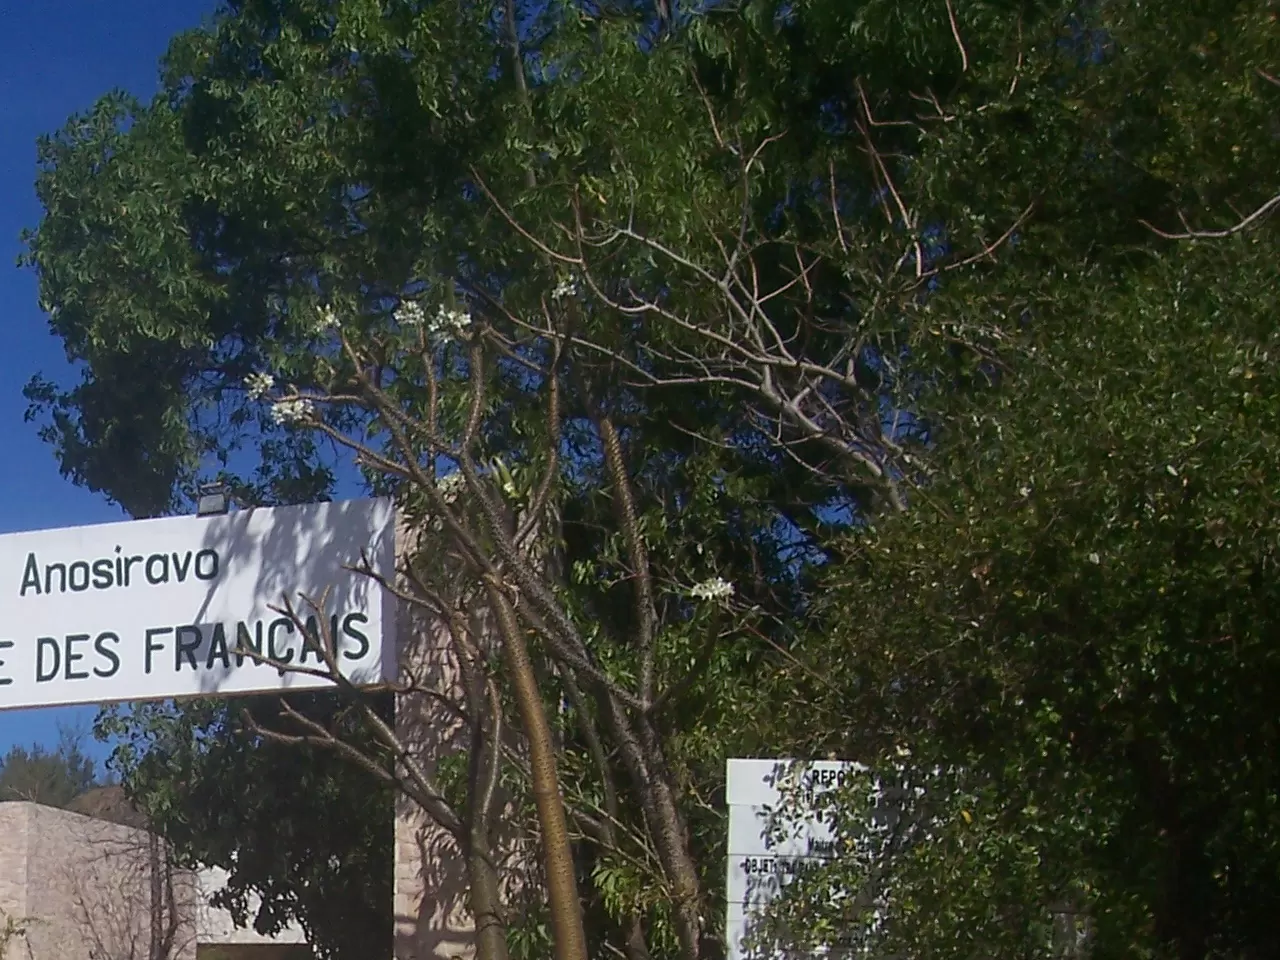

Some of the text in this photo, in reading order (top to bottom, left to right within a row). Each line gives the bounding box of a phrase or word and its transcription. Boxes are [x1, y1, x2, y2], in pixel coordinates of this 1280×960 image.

[20, 545, 220, 597] Anosiravo
[36, 631, 121, 683] DES
[144, 612, 370, 677] FRANÇAIS
